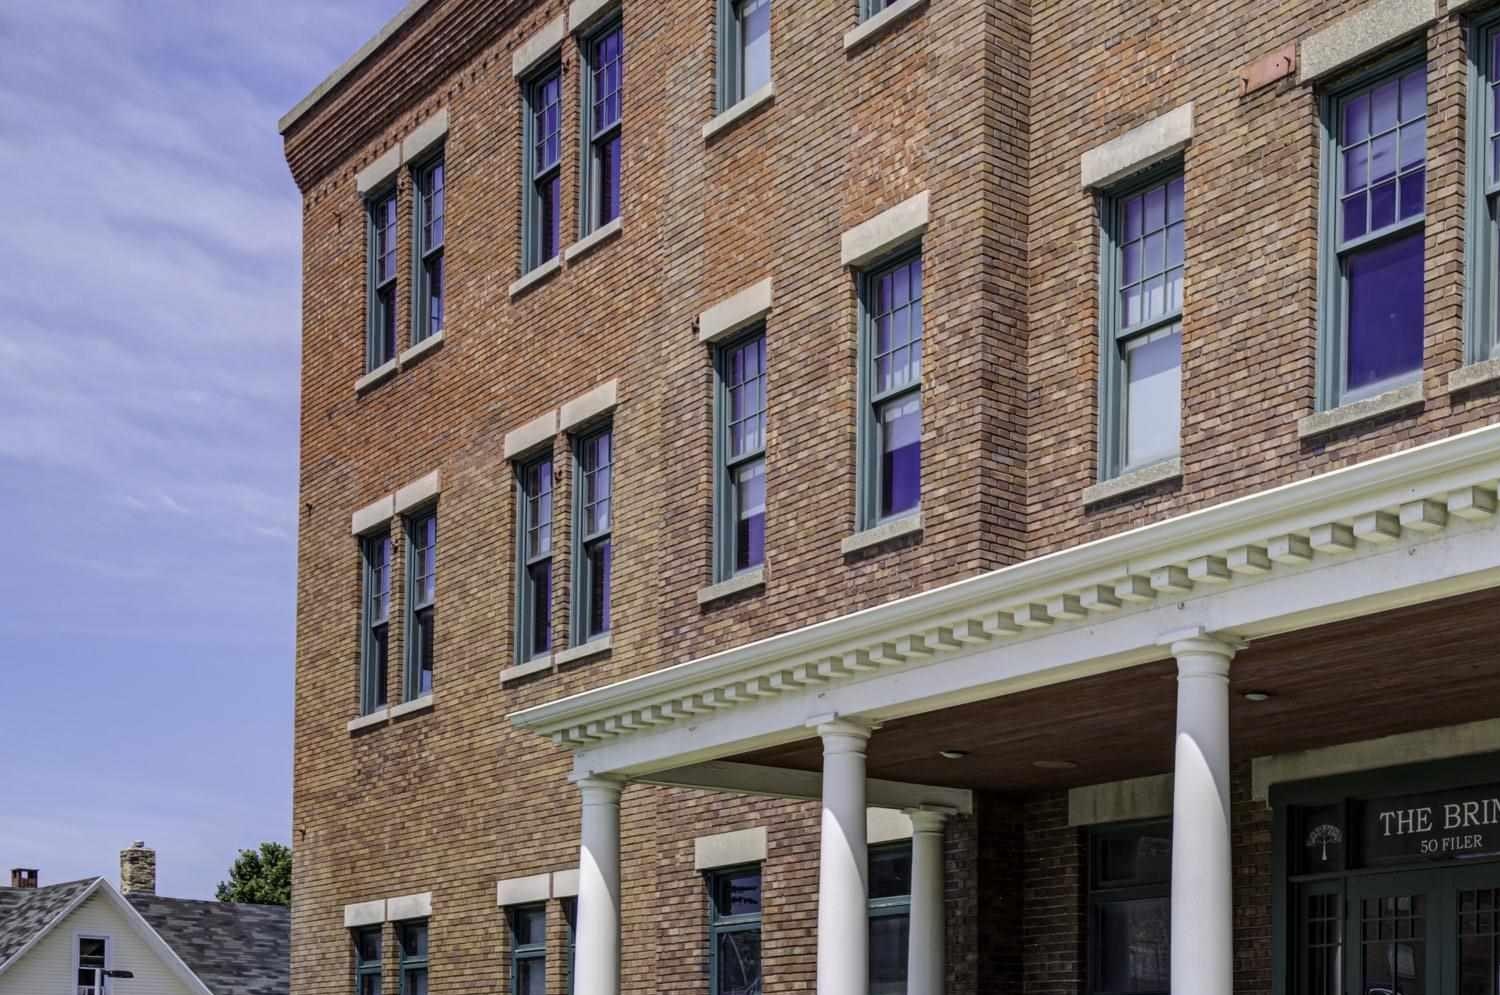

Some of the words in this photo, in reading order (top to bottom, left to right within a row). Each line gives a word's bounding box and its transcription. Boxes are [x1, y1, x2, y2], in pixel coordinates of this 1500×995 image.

[1379, 807, 1433, 836] THE
[1420, 839, 1438, 853] 50
[1442, 834, 1483, 851] FILER
